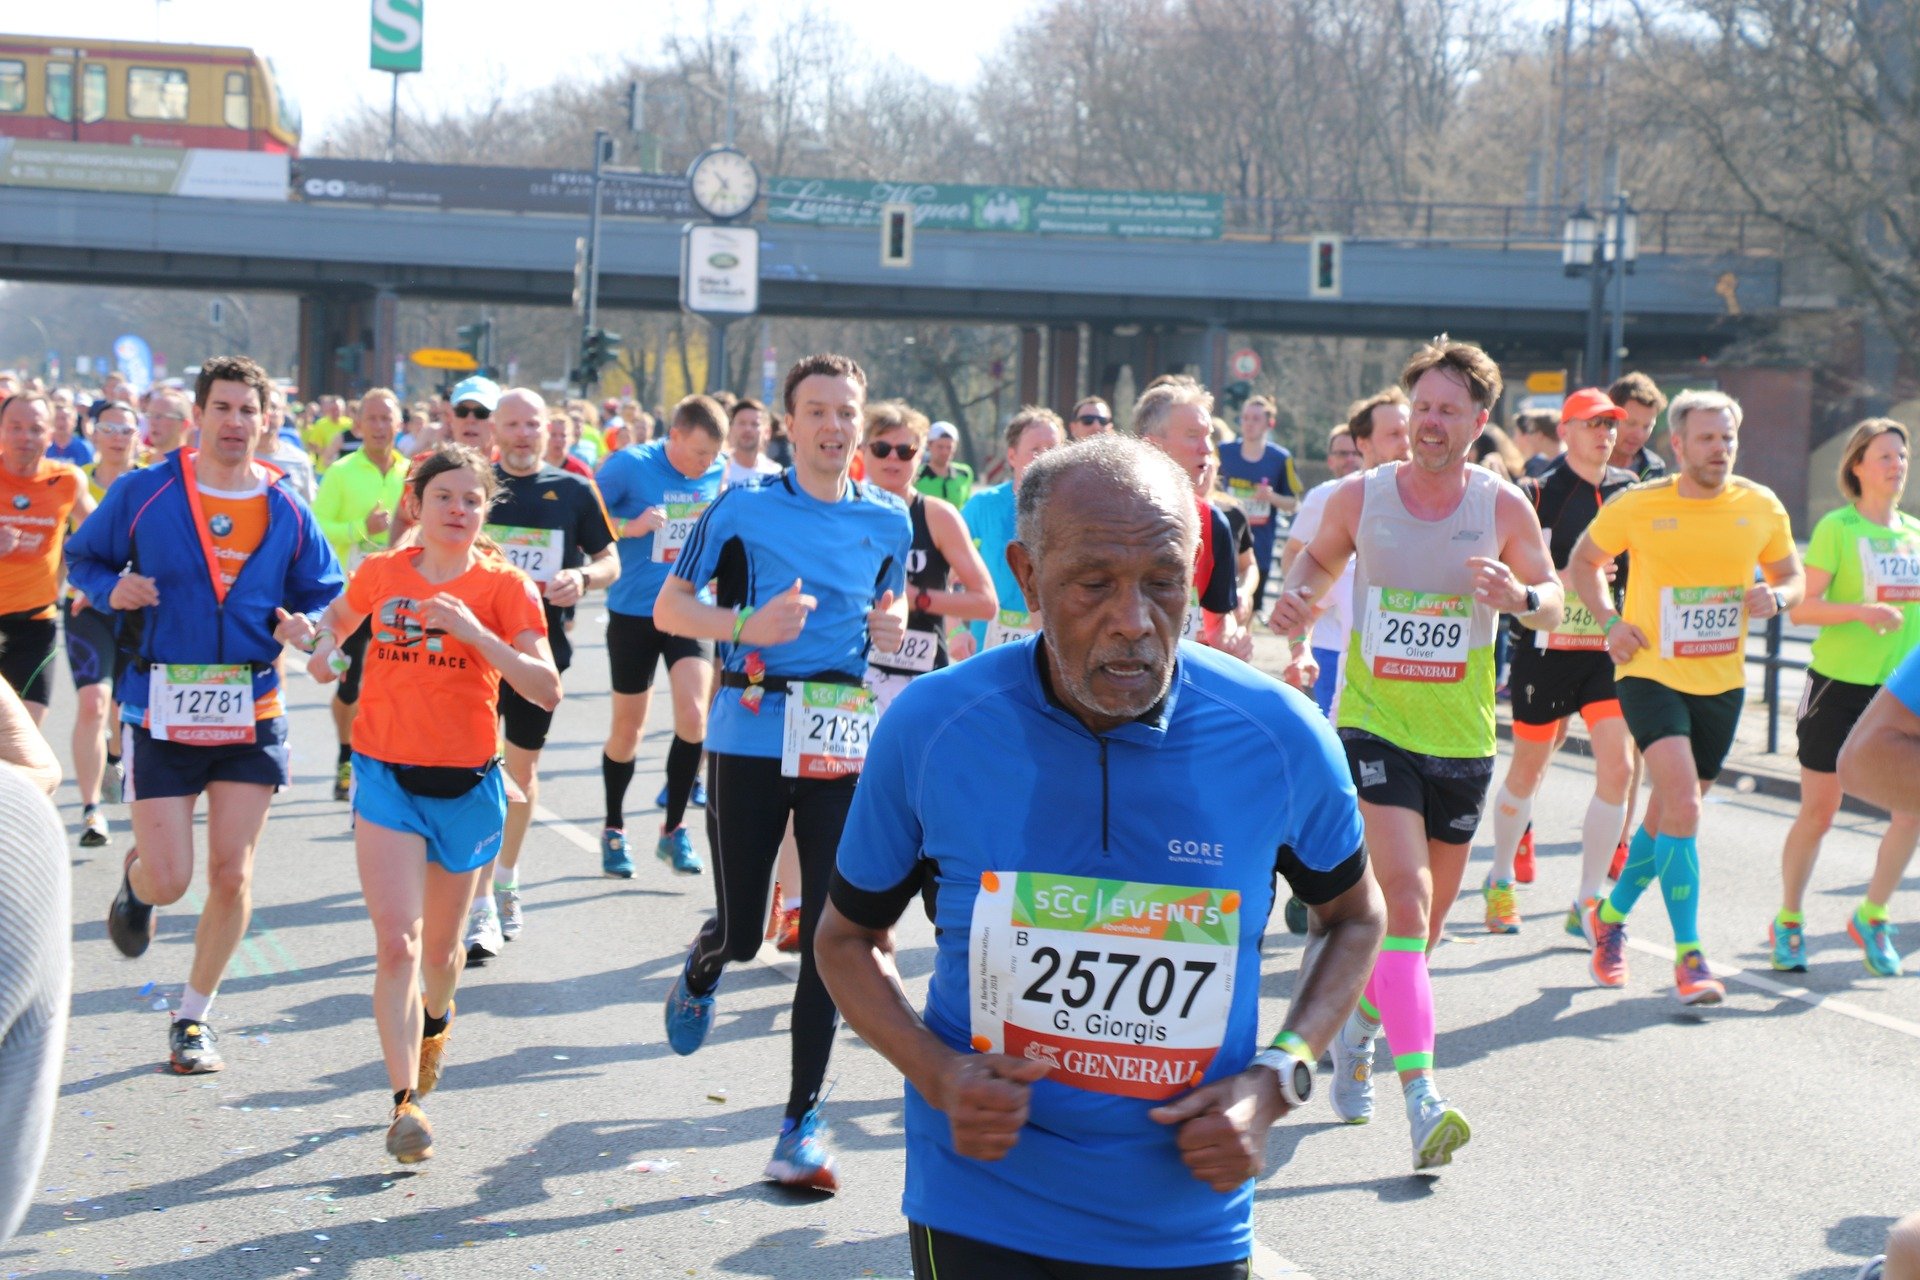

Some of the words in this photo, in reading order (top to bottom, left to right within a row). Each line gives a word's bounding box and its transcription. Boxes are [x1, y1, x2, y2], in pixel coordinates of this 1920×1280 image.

[372, 0, 421, 52] S
[509, 550, 543, 570] 312
[1562, 606, 1597, 627] 348
[1682, 608, 1739, 630] 15852
[1384, 618, 1462, 648] 26369
[378, 647, 420, 664] GIANT
[427, 654, 467, 670] RACE
[1406, 646, 1434, 658] Oliver
[1400, 663, 1458, 678] GENERALI
[174, 690, 243, 714] 12781
[808, 714, 871, 745] 21251
[1168, 840, 1224, 858] GORE
[1034, 889, 1088, 914] SCC
[1111, 899, 1220, 926] EVENTS
[1016, 931, 1029, 946] B
[1022, 946, 1217, 1019] 25707
[1053, 1010, 1075, 1032] G.
[1086, 1014, 1168, 1045] Giorgis
